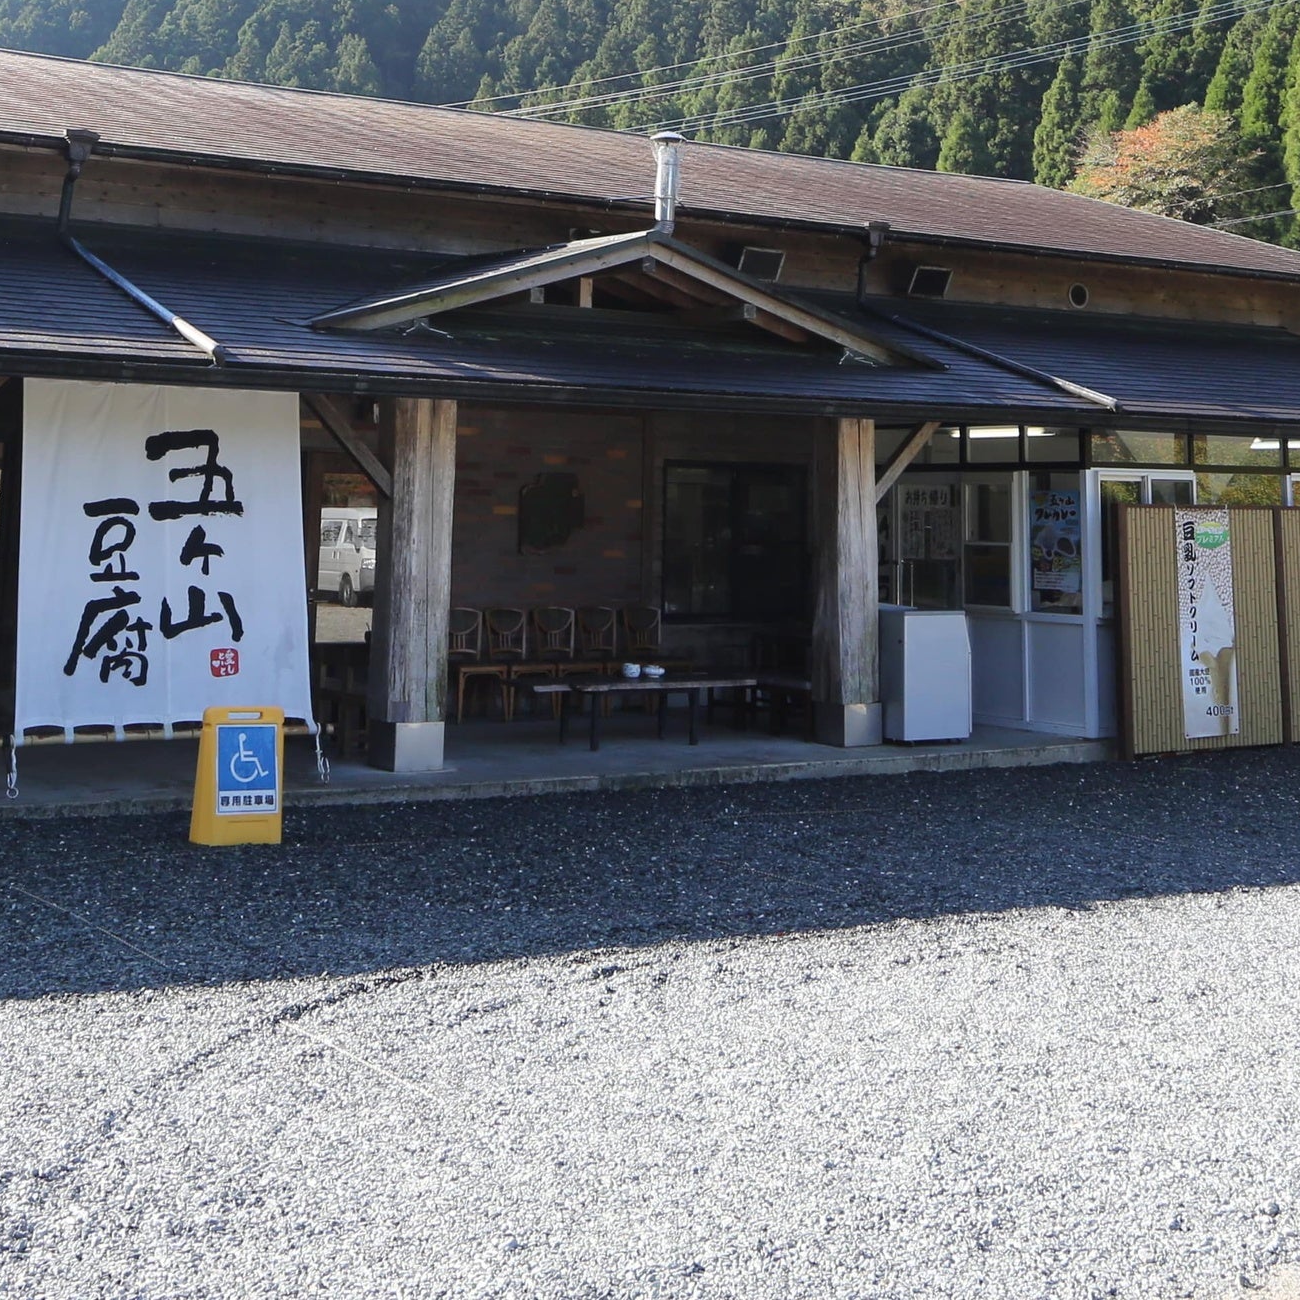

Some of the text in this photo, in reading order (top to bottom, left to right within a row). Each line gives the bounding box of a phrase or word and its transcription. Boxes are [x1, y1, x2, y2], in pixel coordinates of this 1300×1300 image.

[63, 498, 153, 686] 豆腐
[220, 794, 274, 807] 専用駐車場
